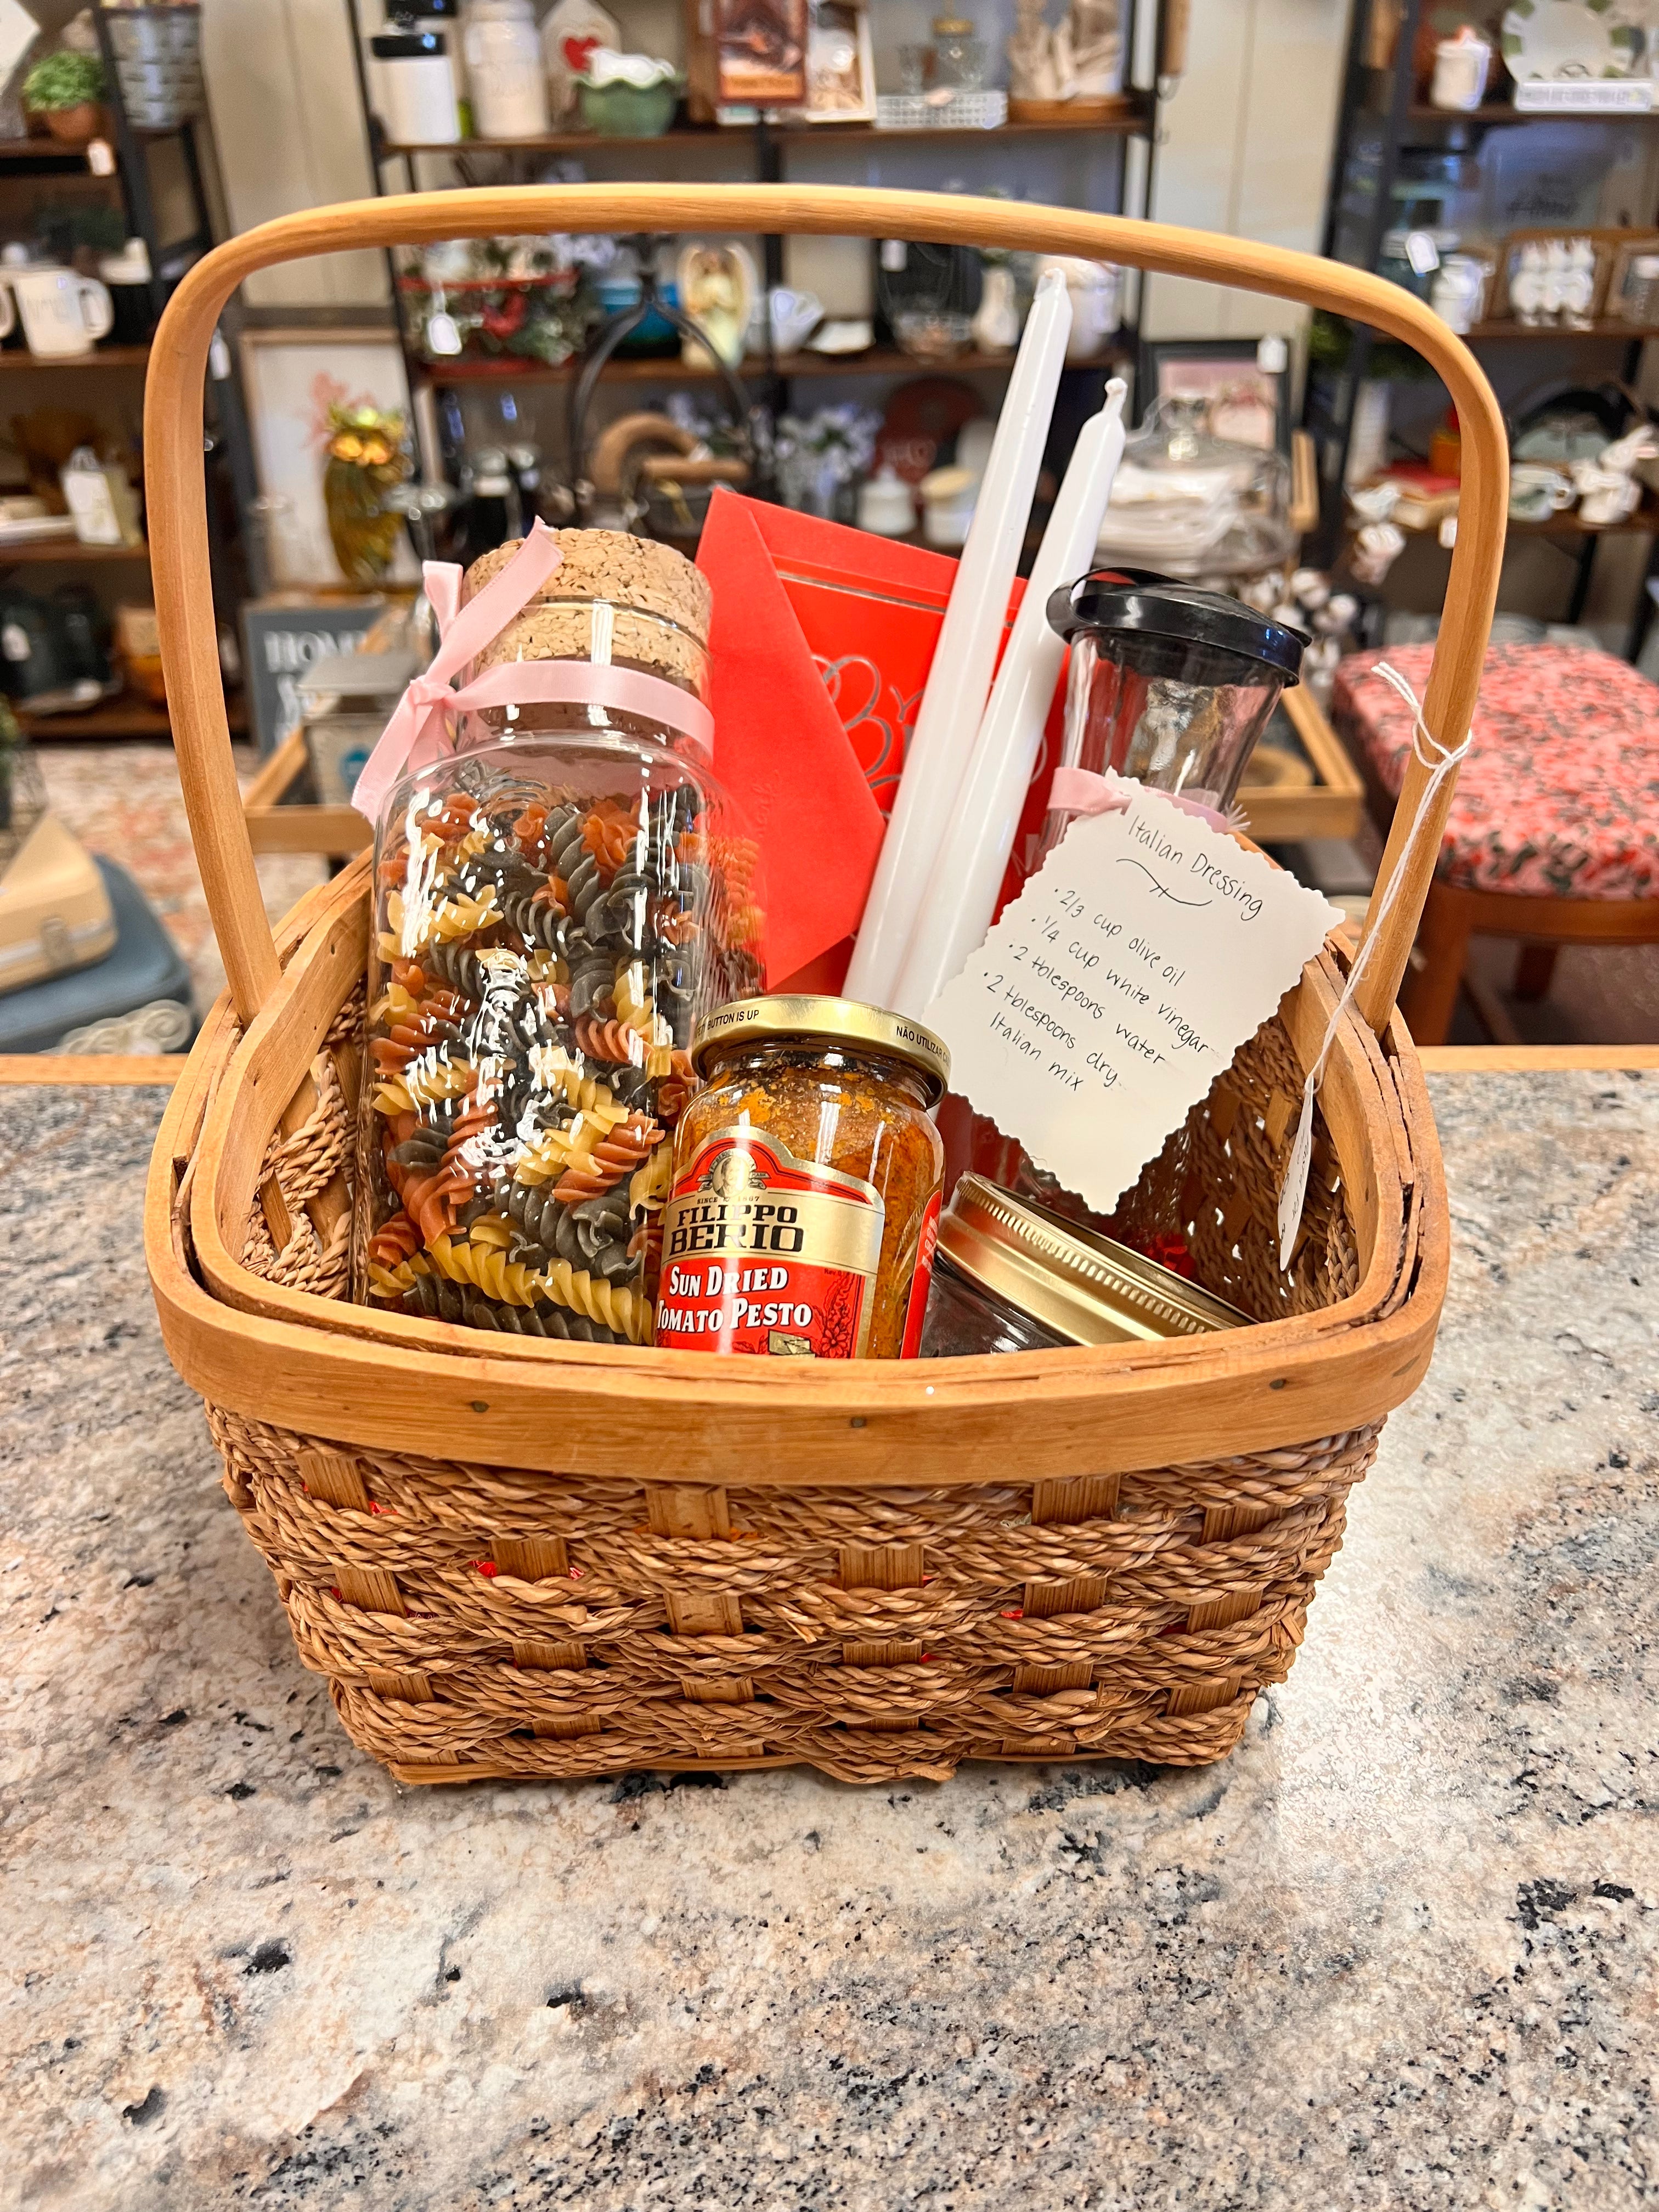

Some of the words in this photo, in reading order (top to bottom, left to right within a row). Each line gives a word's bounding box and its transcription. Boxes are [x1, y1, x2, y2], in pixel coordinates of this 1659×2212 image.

[264, 631, 369, 673] HOM
[1128, 815, 1183, 864] Italian
[1190, 853, 1263, 921] Dressing
[1059, 890, 1085, 918] 2/3
[1094, 913, 1122, 938] cup
[1128, 938, 1161, 968] olive
[1162, 966, 1186, 987] oil
[1014, 946, 1029, 961] 2
[1116, 1023, 1165, 1064] water
[1069, 941, 1099, 969] cup
[1106, 968, 1150, 1005] white
[1158, 1003, 1209, 1054] vinegar
[707, 1012, 735, 1030] BUTTON
[736, 1011, 745, 1022] IS
[747, 1009, 759, 1020] UP
[986, 974, 1004, 994] 2
[1003, 984, 1076, 1049] tblespoons
[1086, 1052, 1118, 1087] dry
[896, 1025, 915, 1041] NÃO
[916, 1034, 943, 1059] UTILIZAR
[990, 1011, 1041, 1061] Italian
[1048, 1062, 1084, 1091] mix
[677, 1204, 798, 1227] FILIPPO
[697, 1197, 718, 1205] SINCE
[669, 1223, 804, 1256] BERIO
[669, 1265, 702, 1297] SUN
[705, 1265, 788, 1296] DRIED
[729, 1297, 812, 1329] PESTO
